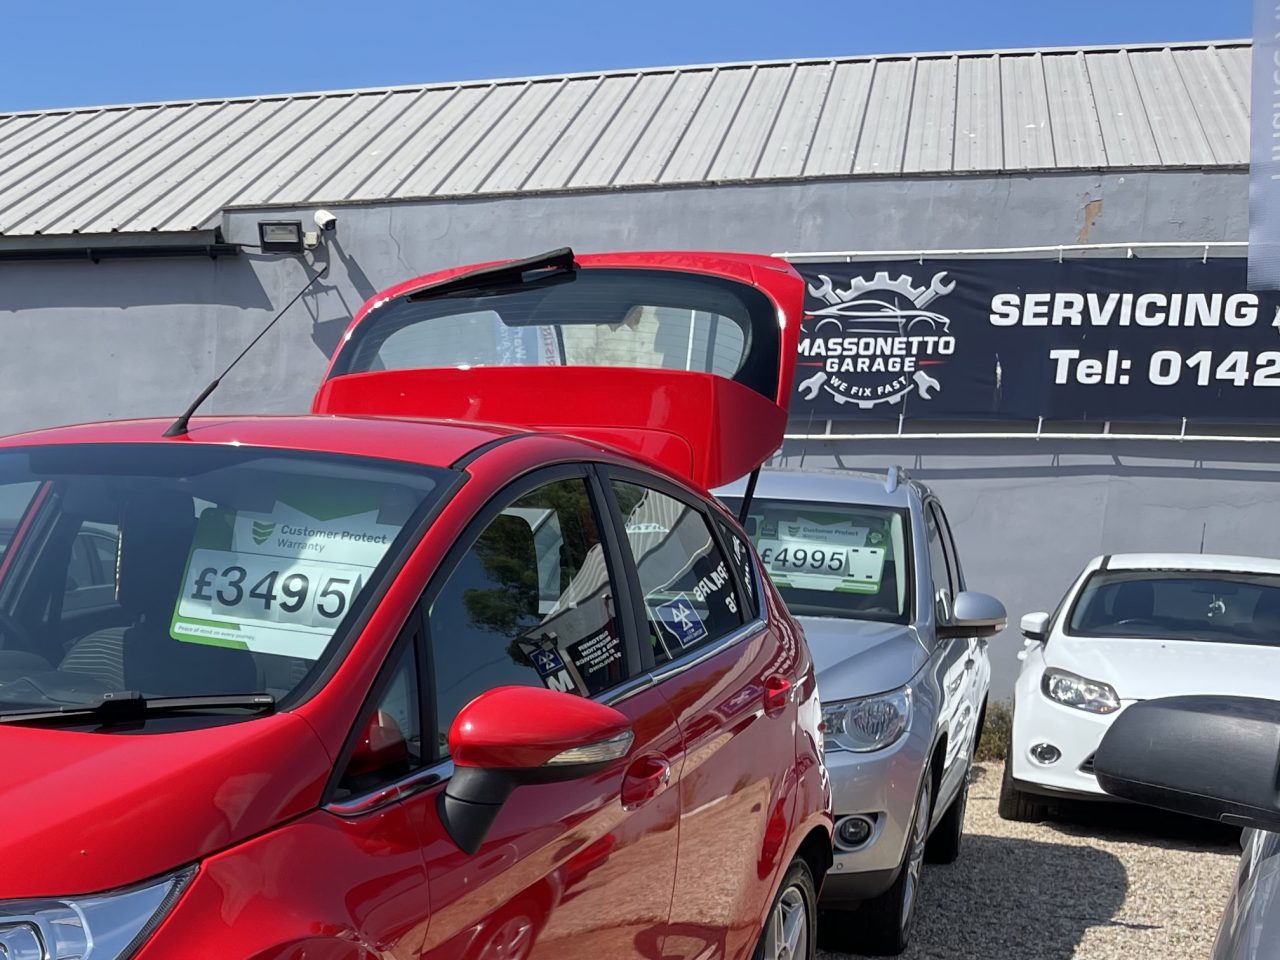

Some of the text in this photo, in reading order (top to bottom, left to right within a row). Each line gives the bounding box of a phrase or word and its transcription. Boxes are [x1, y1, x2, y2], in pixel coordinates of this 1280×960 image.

[989, 293, 1258, 327] SERVICING
[798, 336, 955, 357] MASSONETTO
[825, 357, 916, 373] GARAGE
[1050, 348, 1280, 387] Tel: 0142
[829, 376, 907, 396] WE FIX FAST
[280, 524, 388, 545] Customer Protect
[277, 539, 325, 553] Warranty
[761, 548, 844, 571] £4995
[191, 565, 350, 618] £3495
